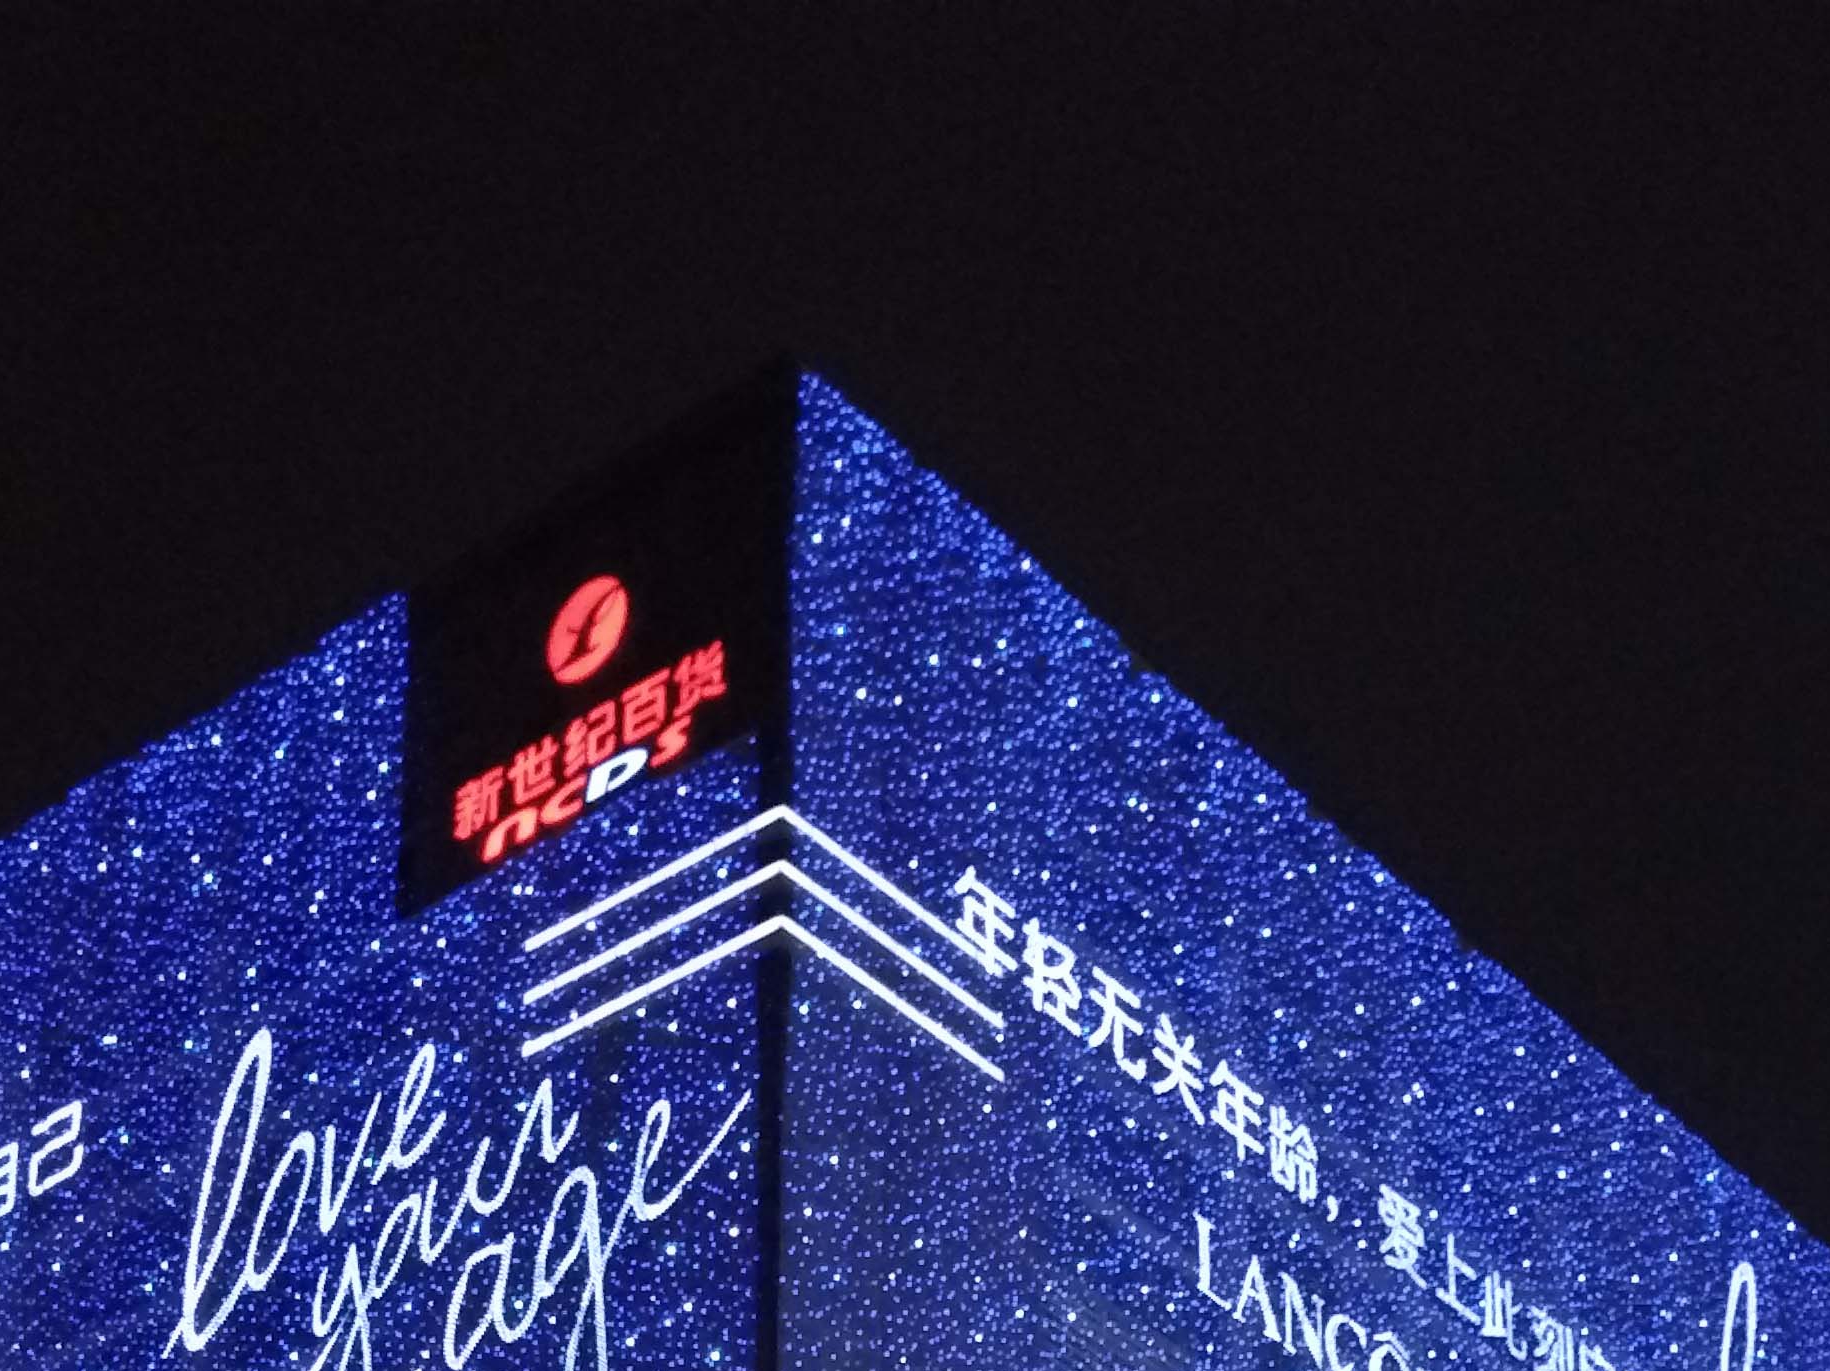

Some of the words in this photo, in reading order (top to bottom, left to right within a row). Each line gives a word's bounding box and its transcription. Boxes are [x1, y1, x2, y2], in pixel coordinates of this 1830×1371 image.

[452, 639, 727, 841] 新世纪百货
[161, 1028, 447, 1360] love
